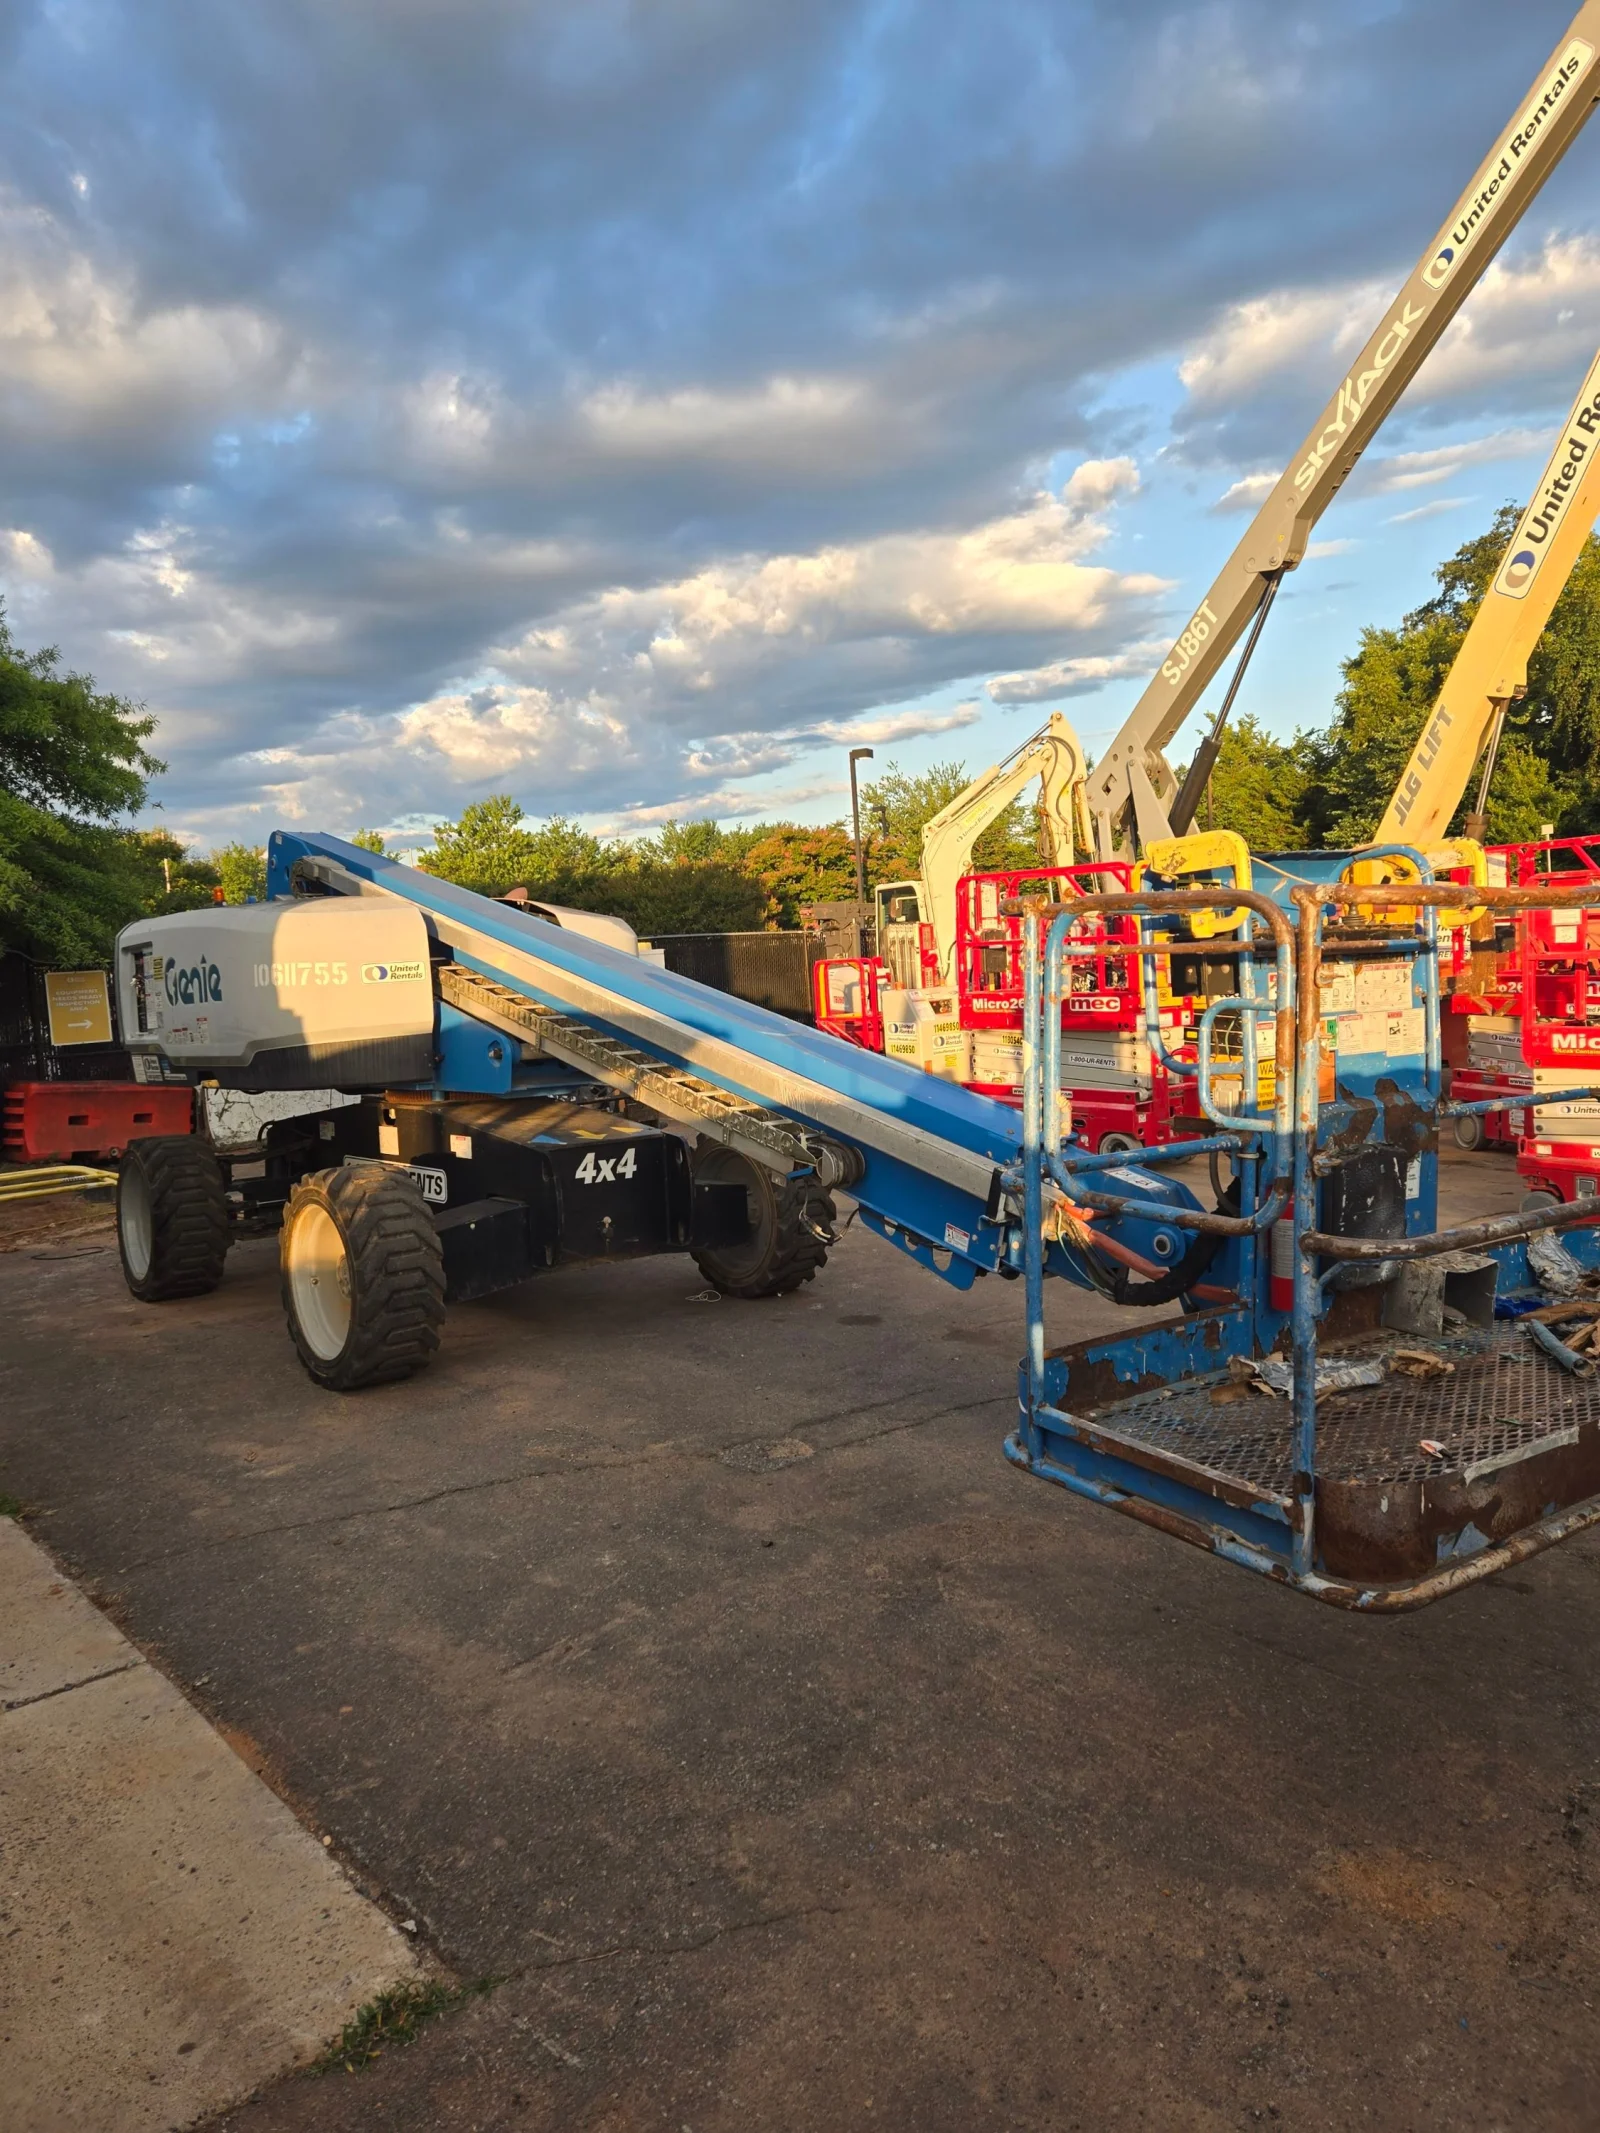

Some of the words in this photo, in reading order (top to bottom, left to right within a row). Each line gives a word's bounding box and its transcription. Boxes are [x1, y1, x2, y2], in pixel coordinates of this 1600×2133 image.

[1453, 158, 1511, 244] United
[1509, 56, 1579, 158] Rentals
[1294, 300, 1426, 491] SKYJACK
[1525, 437, 1588, 544] United
[1161, 599, 1218, 685] SJ86T
[1394, 771, 1423, 827] JLG
[1417, 703, 1453, 772] LIFT
[165, 954, 222, 1006] Genie
[253, 962, 348, 987] 10611755
[390, 964, 419, 973] United
[390, 972, 423, 980] Rentals
[1071, 998, 1119, 1009] mec
[575, 1148, 637, 1184] 4x4
